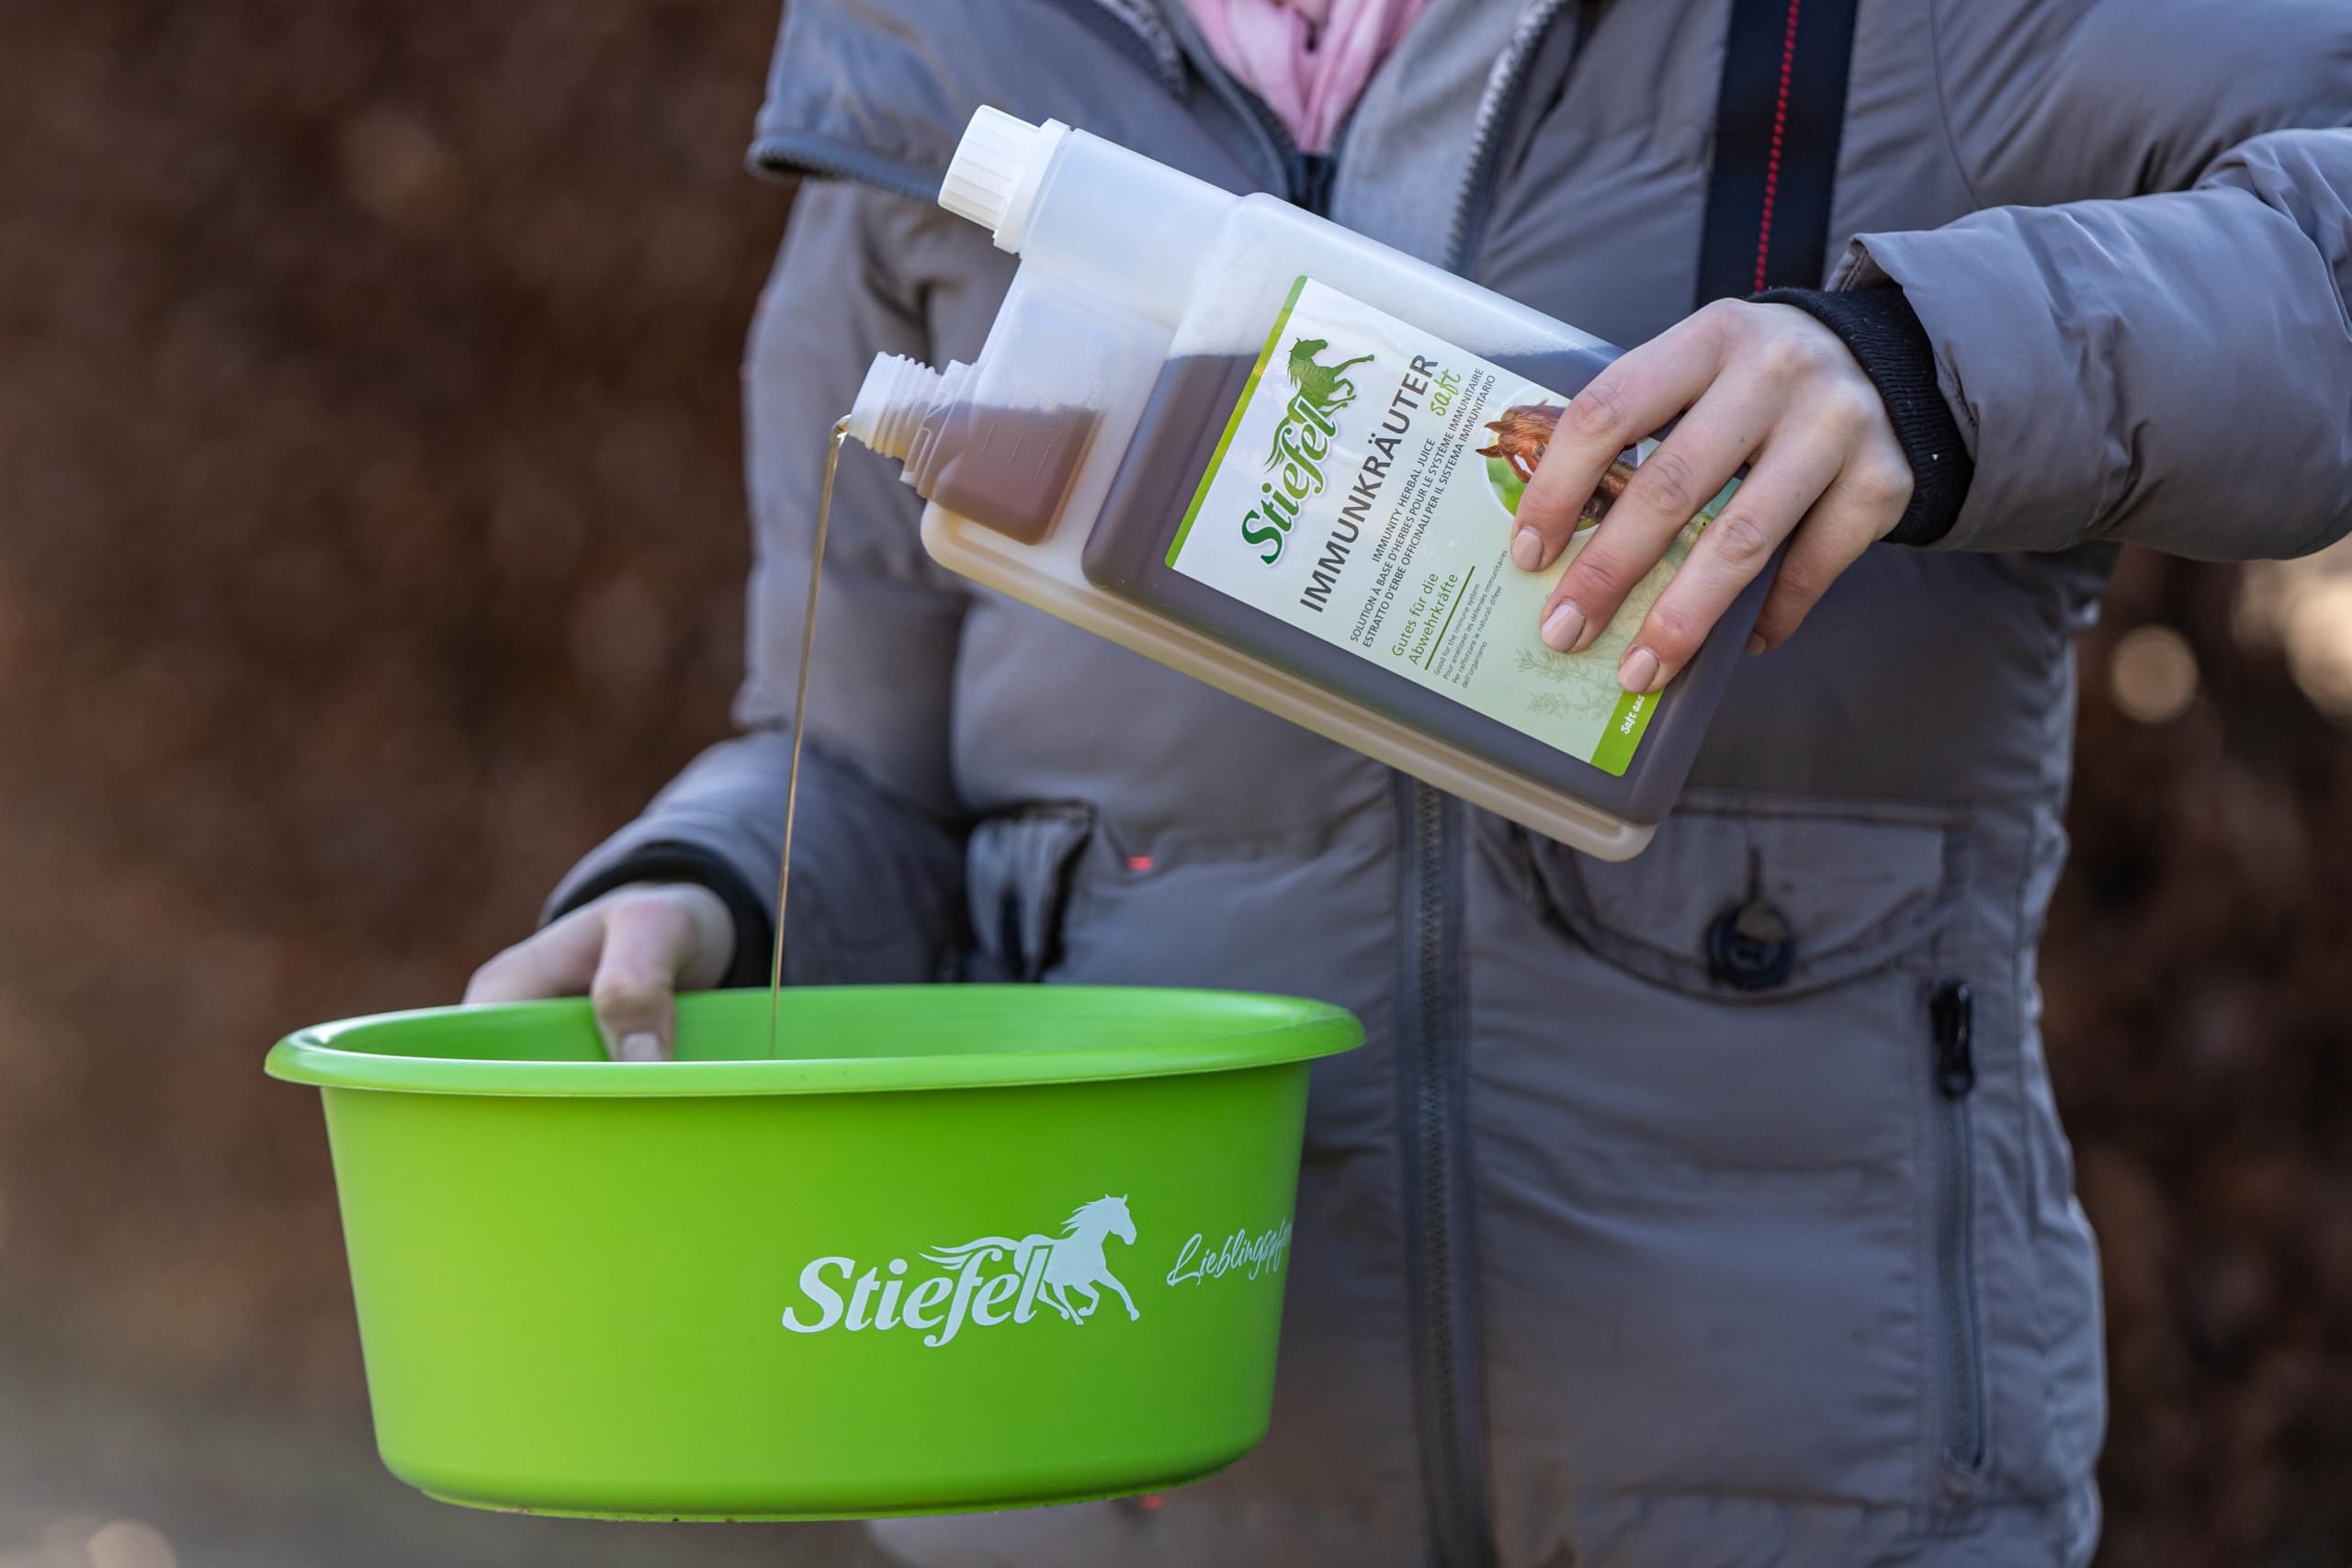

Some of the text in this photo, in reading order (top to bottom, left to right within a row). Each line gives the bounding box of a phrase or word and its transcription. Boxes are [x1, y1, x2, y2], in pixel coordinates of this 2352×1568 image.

[1430, 368, 1461, 416] saft
[1448, 368, 1484, 432] IMMUNITAIRE
[1241, 400, 1336, 564] Stiefel
[1299, 355, 1439, 613] IMMUNKRÄUTER
[1422, 476, 1433, 488] LE
[1428, 432, 1453, 476] SYSTÈME
[1363, 601, 1389, 648] ESTRATTO
[1401, 514, 1430, 566] OFFICINALI
[1425, 495, 1440, 514] PER
[1434, 484, 1444, 495] IL
[1439, 444, 1464, 485] SISTEMA
[1458, 375, 1496, 442] IMMUNITARIO
[1371, 438, 1435, 562] IMMUNITY HERBAL JUICE
[1408, 489, 1428, 515] POUR
[1371, 585, 1382, 596] À
[1376, 561, 1393, 586] BASE
[1350, 595, 1377, 642] SOLUTION
[1392, 573, 1439, 656] Gutes für die
[1408, 574, 1458, 666] Abwehrkräfte
[1433, 583, 1480, 675] Good for the immune system
[1442, 664, 1453, 680] Pour
[1464, 623, 1474, 632] les
[1483, 550, 1508, 593] immunitaires
[1452, 672, 1461, 683] Per
[1472, 631, 1480, 639] le
[1489, 586, 1502, 605] difese
[1621, 712, 1636, 735] Saft
[1167, 1219, 1292, 1286] Lieblingspf
[782, 1244, 1055, 1348] Stiefel
